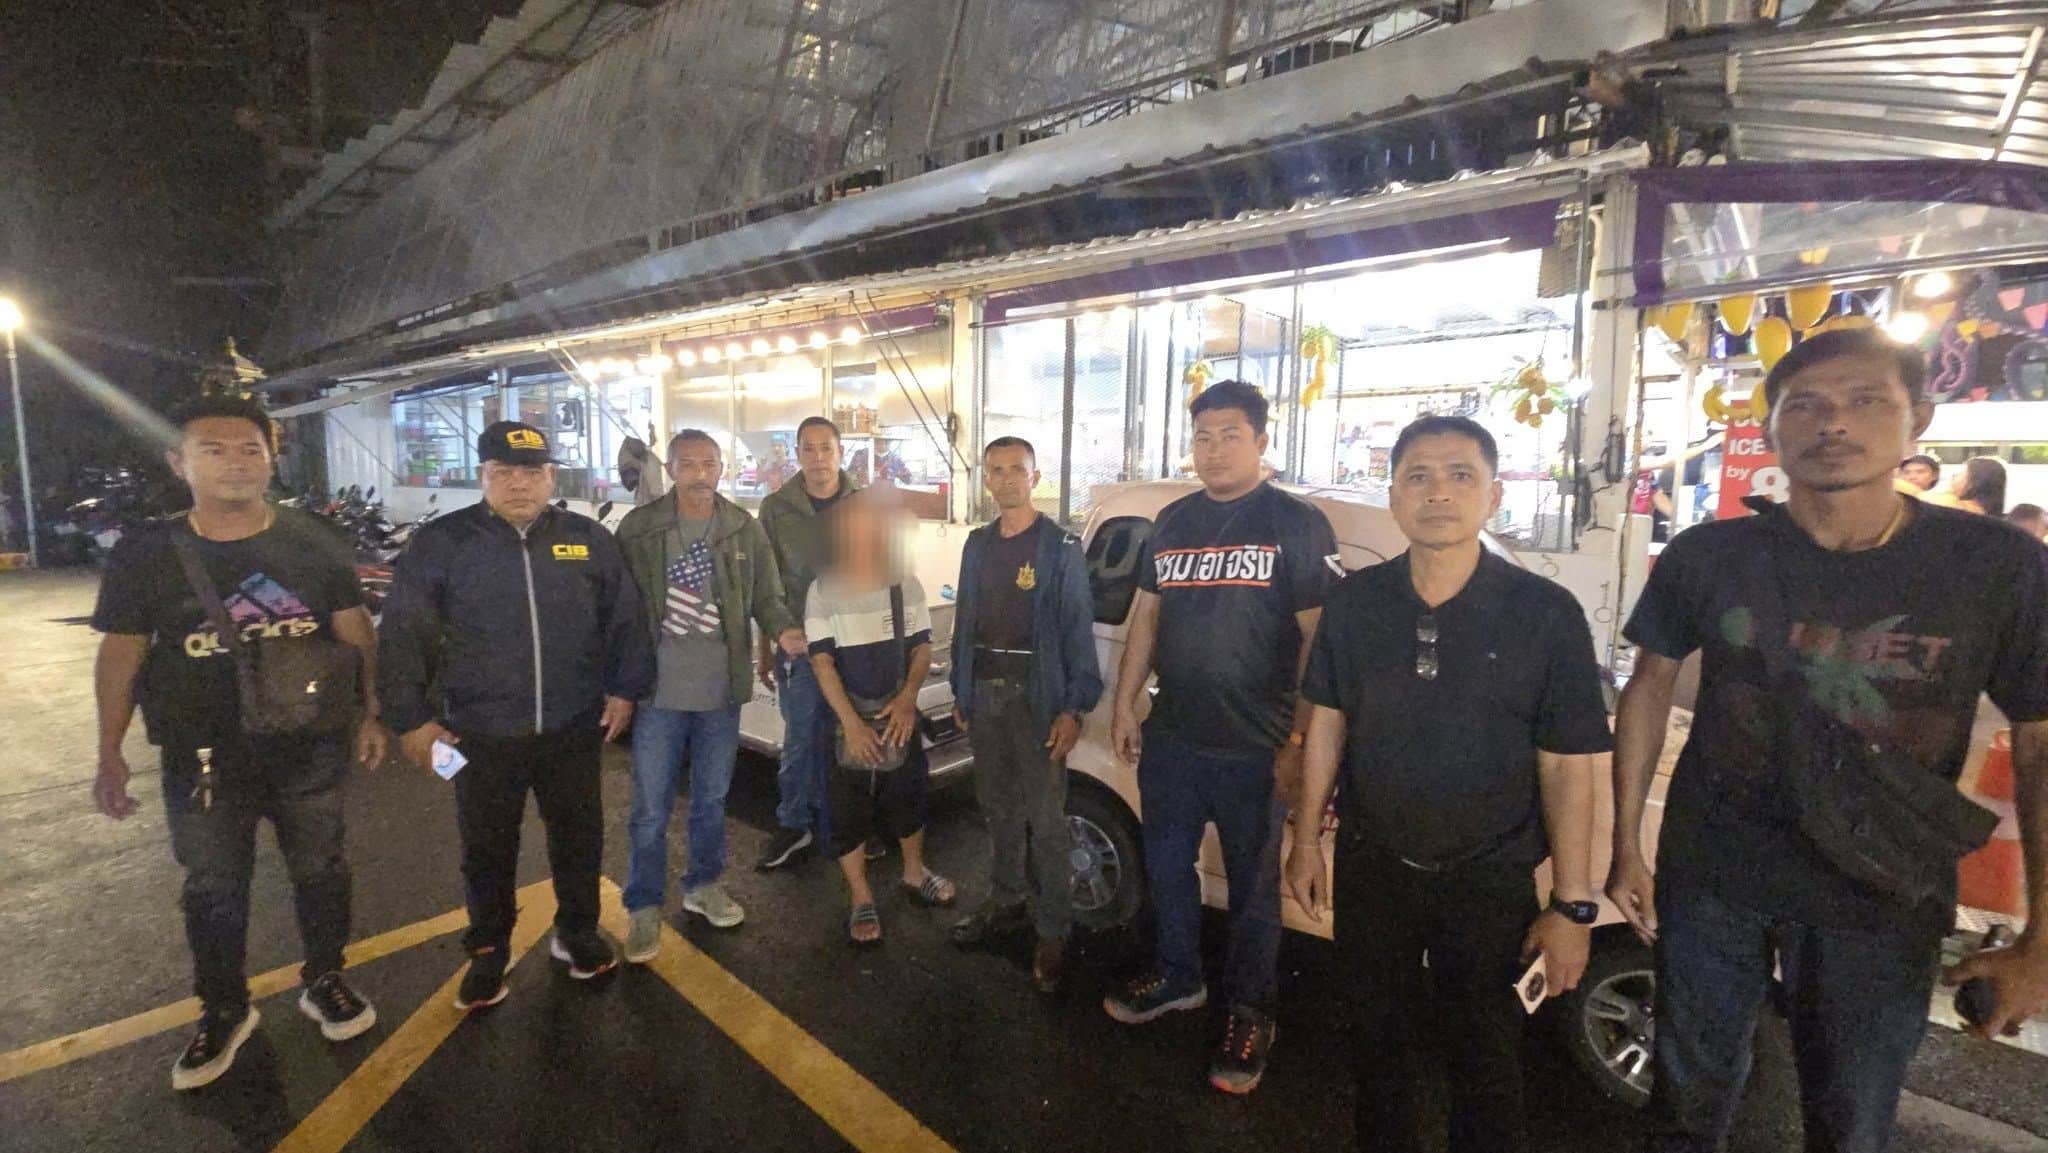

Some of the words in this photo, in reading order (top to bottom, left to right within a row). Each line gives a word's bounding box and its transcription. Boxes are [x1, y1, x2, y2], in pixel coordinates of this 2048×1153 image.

[506, 429, 546, 446] CIB
[1728, 437, 1767, 456] ICE
[1725, 465, 1752, 481] by
[552, 544, 589, 557] CIB
